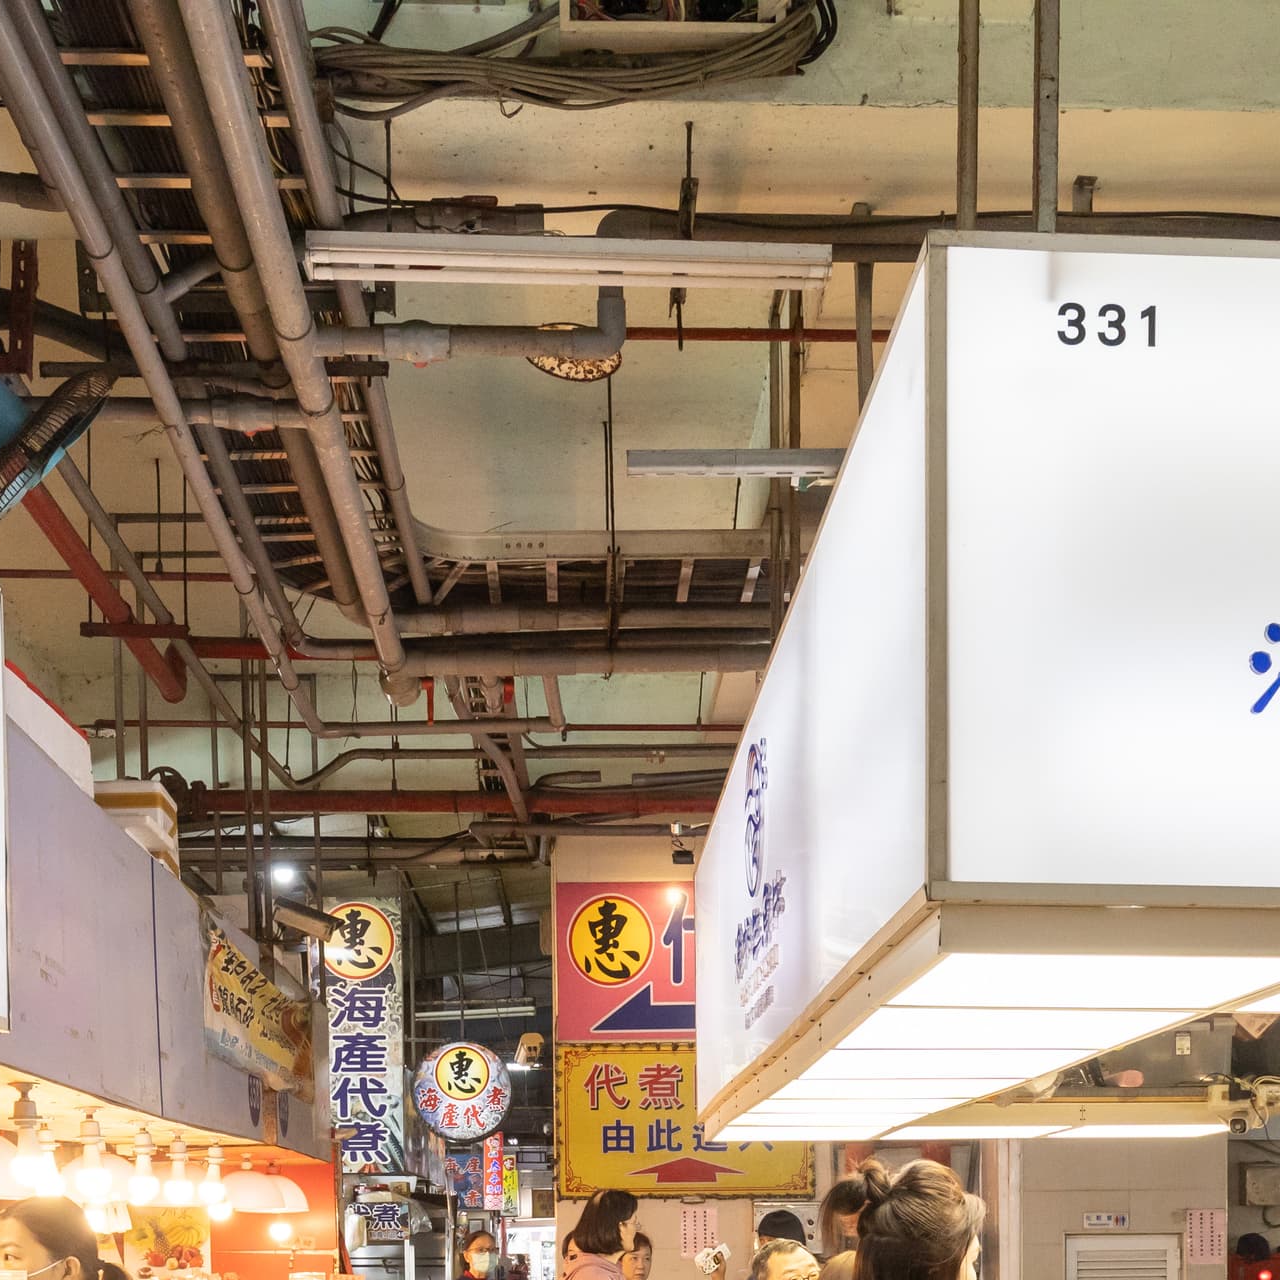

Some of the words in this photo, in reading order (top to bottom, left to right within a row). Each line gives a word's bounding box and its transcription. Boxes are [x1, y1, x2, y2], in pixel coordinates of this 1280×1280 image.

[1058, 302, 1160, 347] 331
[585, 901, 640, 979] 惠
[331, 987, 389, 1164] 海產代煮
[448, 1050, 482, 1094] 惠
[584, 1063, 696, 1110] 代煮
